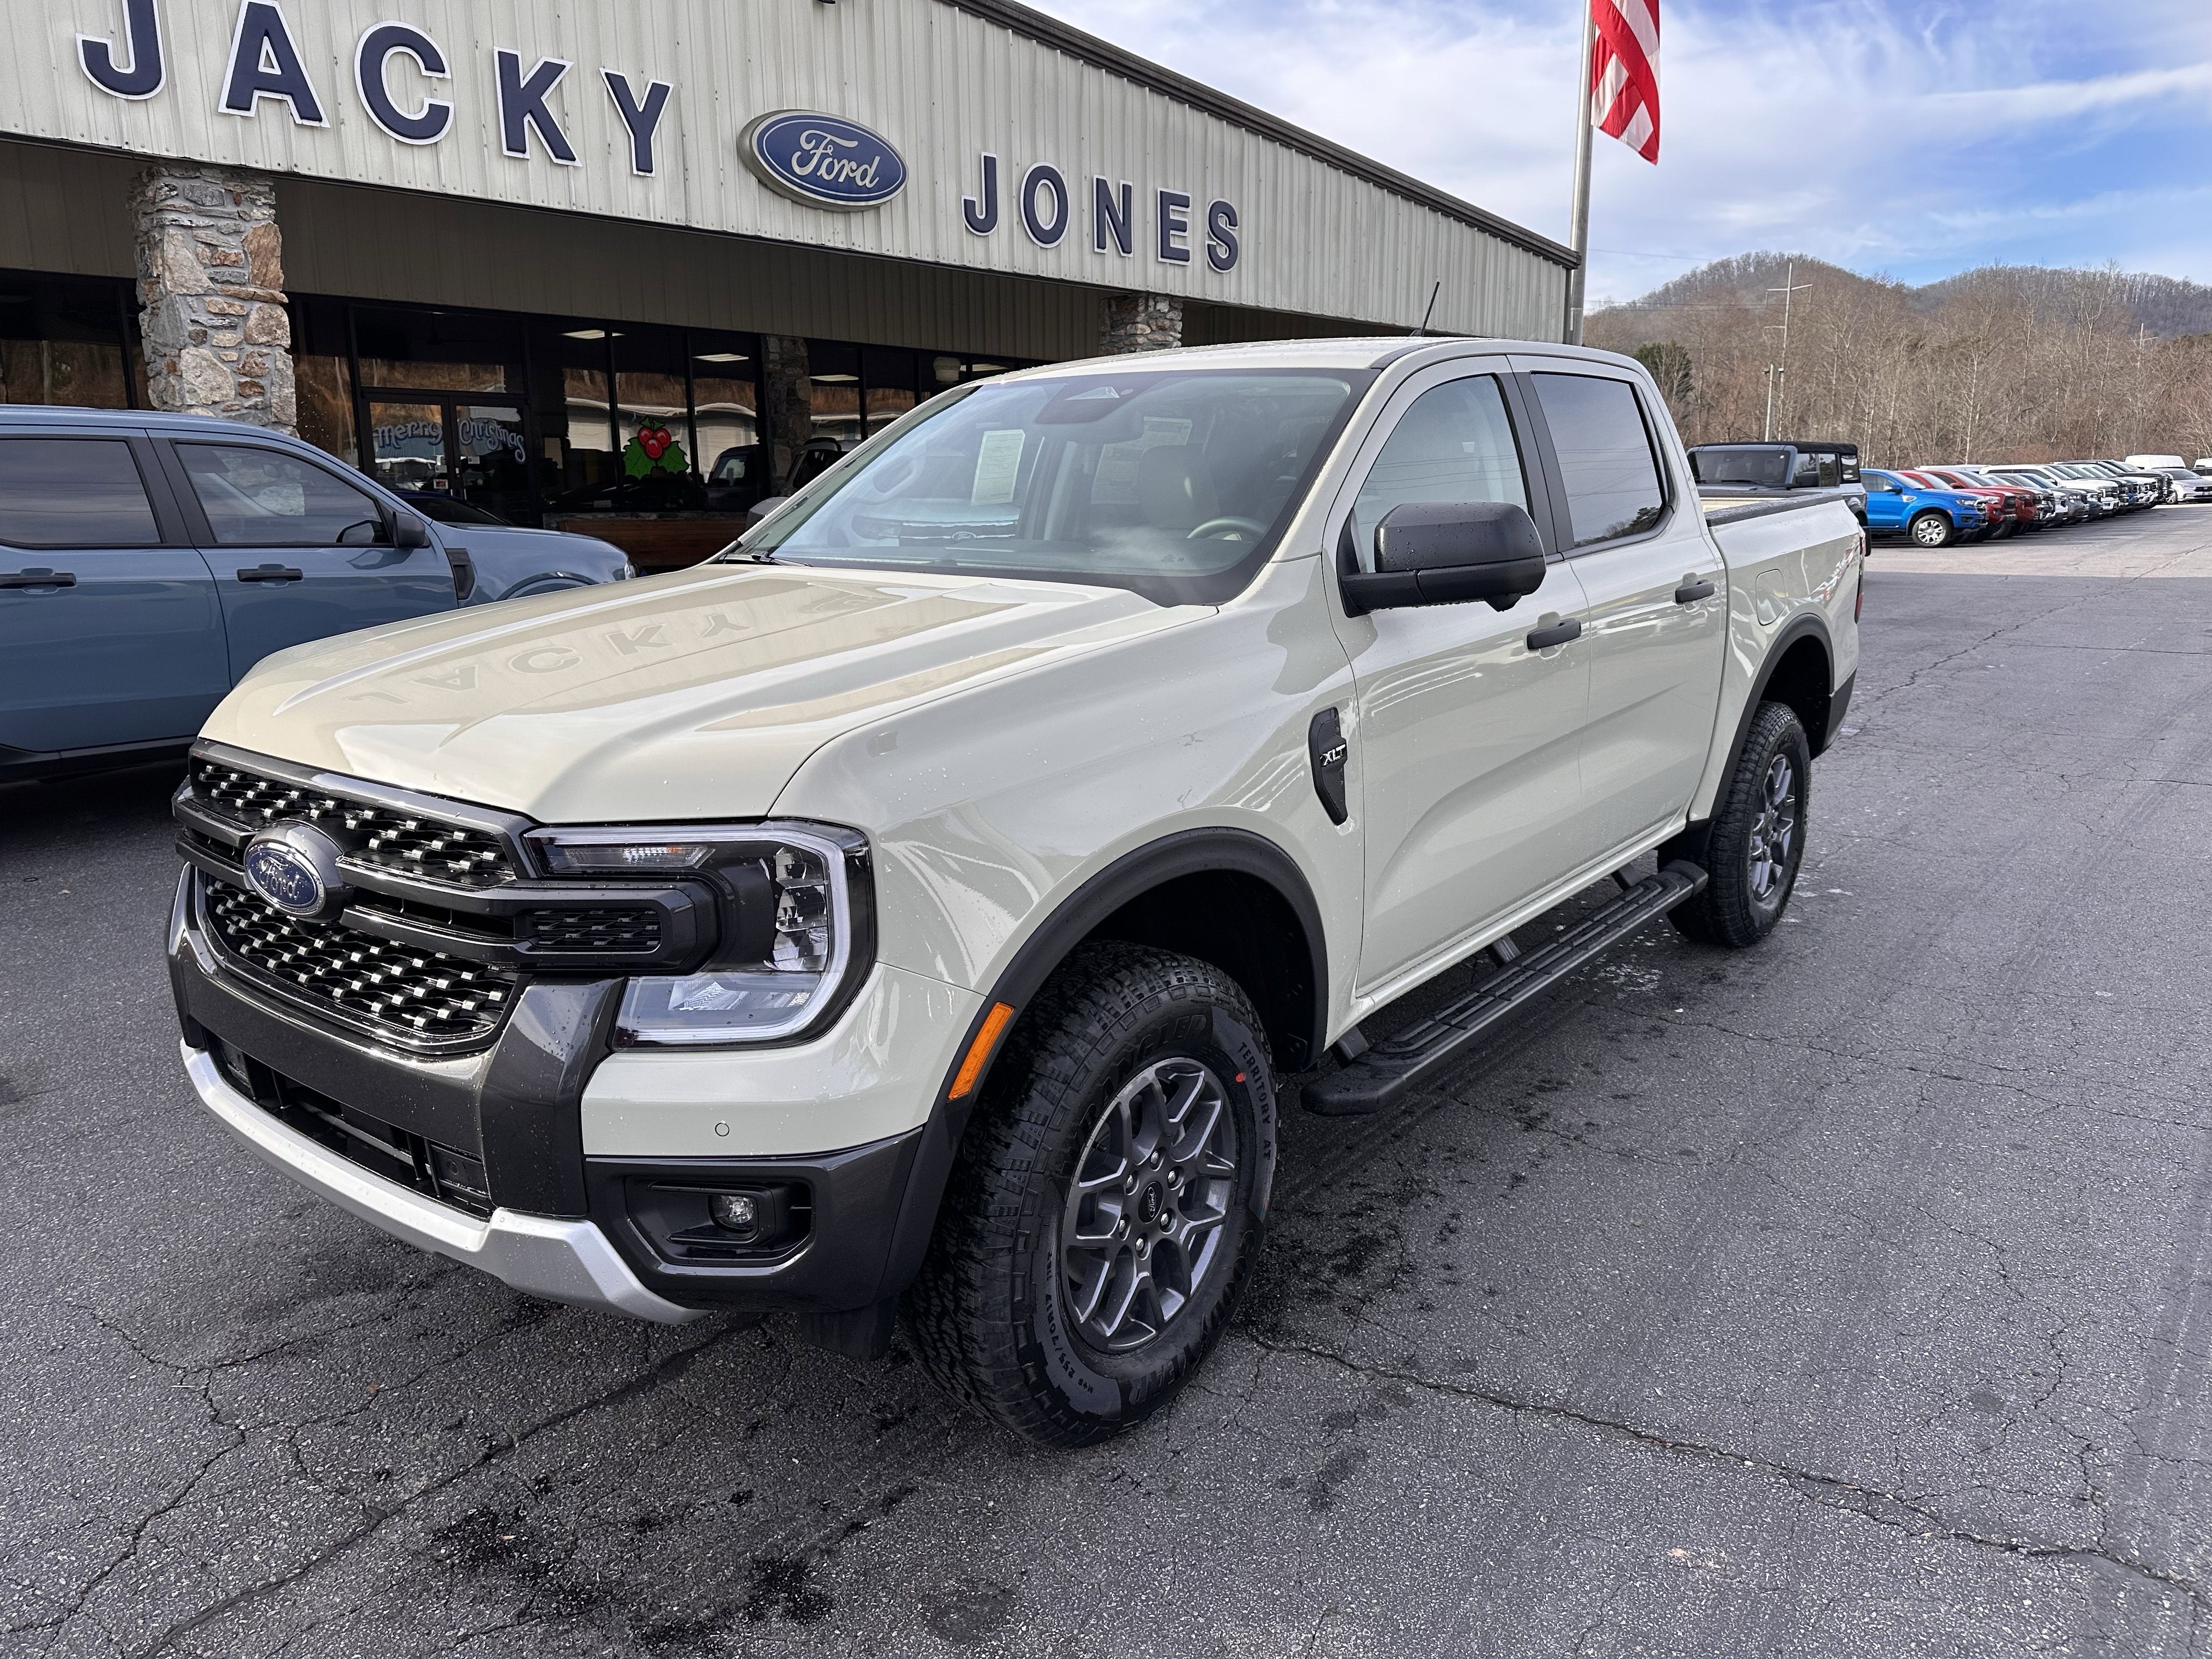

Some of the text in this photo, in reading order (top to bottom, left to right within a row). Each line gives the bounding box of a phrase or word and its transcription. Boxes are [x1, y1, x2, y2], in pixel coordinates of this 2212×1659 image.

[76, 0, 1239, 274] JACKY JONES
[790, 129, 881, 189] Ford
[459, 418, 526, 464] Christmas
[1319, 743, 1346, 766] XLT
[259, 855, 301, 900] Ford
[1237, 1041, 1271, 1125] TERRITORY
